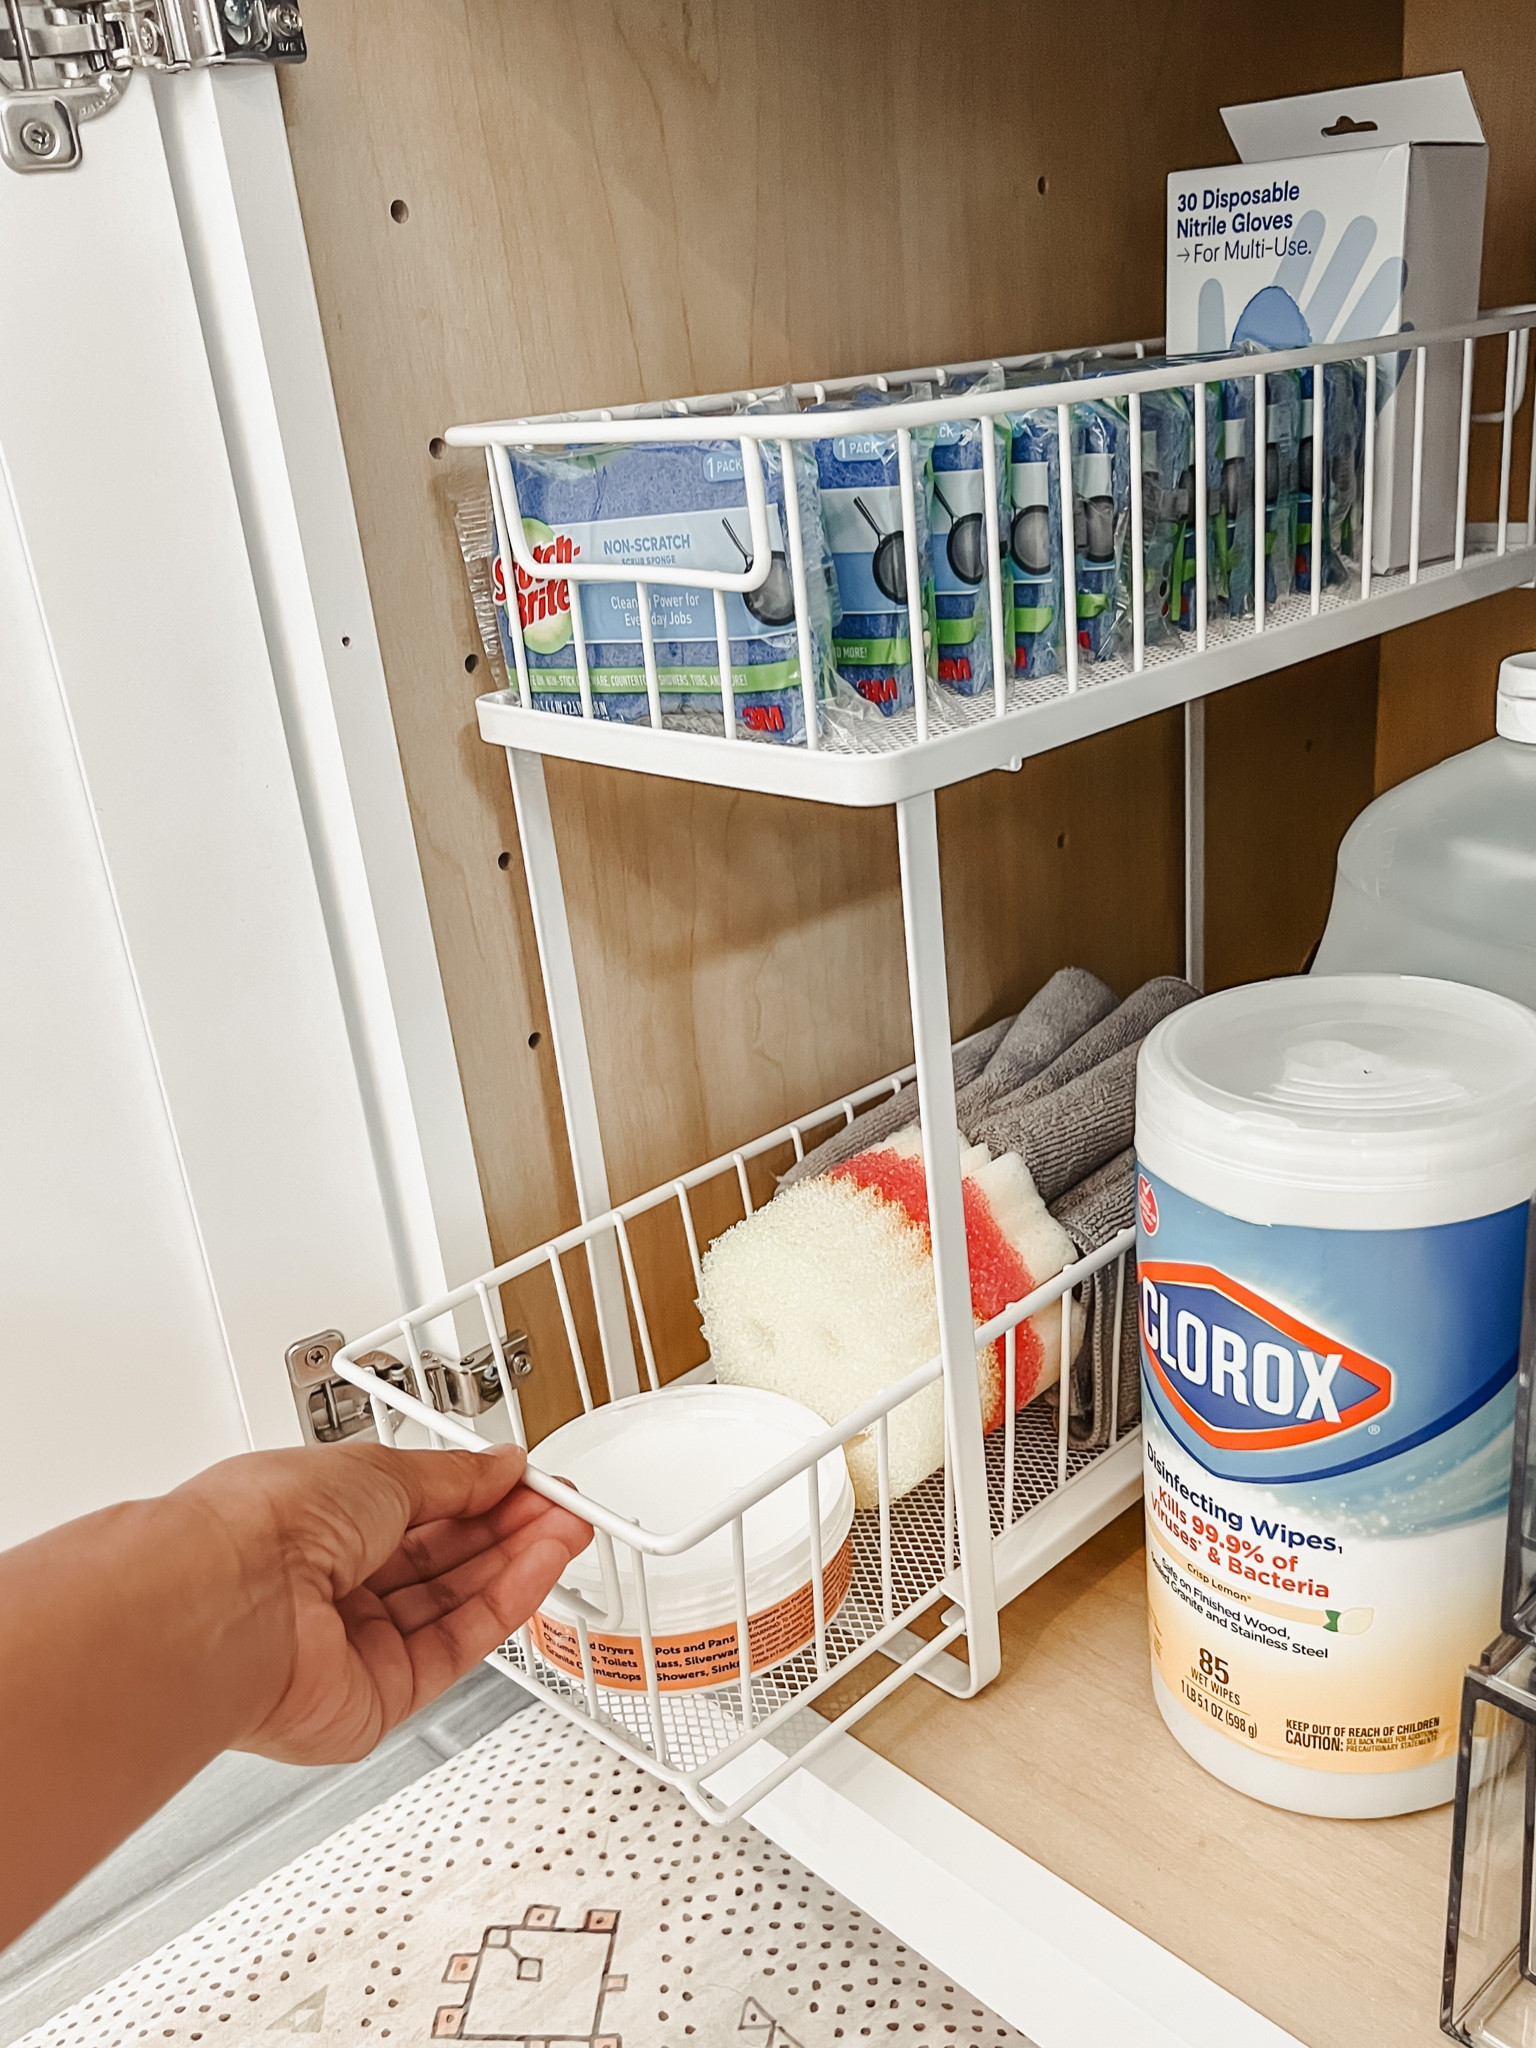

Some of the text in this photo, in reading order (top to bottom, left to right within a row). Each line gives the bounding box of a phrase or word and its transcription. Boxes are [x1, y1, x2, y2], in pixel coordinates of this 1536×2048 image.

[1177, 180, 1300, 212] 30 Disposable
[1177, 212, 1293, 239] Nitrile Gloves
[1194, 236, 1312, 263] For Multi-Use.
[838, 438, 846, 459] 1
[707, 457, 743, 478] 1 PACK
[603, 534, 690, 555] NON-SCRATCH
[653, 594, 684, 607] Power
[685, 592, 700, 606] for
[624, 611, 692, 628] Eveday Jobs
[843, 646, 868, 659] MORE!
[742, 705, 785, 732] 3M
[1142, 1276, 1343, 1424] CLOROX
[1147, 1441, 1243, 1532] Disinfecting
[1158, 1485, 1299, 1572] Kills 99.9% of
[1187, 1563, 1209, 1584] Crisp
[1207, 1546, 1221, 1566] &
[1228, 1556, 1330, 1598] Bacteria
[1161, 1558, 1291, 1640] Safe on Finished Wood,
[1171, 1582, 1204, 1614] Granite
[1206, 1610, 1228, 1628] and
[1231, 1622, 1288, 1651] Stainless
[1292, 1643, 1328, 1659] Steel
[545, 1644, 575, 1667] Granite
[598, 1643, 634, 1655] Dryers
[655, 1635, 736, 1656] Pots and Pans
[601, 1655, 638, 1668] Toilets
[654, 1648, 740, 1669] lass, Silverwar
[1199, 1647, 1230, 1685] 85
[656, 1669, 709, 1681] Showers,
[1190, 1665, 1241, 1706] WET WIPES
[1181, 1679, 1258, 1739] 1 LB 5.1 OZ (598 g)
[1286, 1716, 1440, 1738] KEEP OUT OF REACH OF CHILDREN
[1285, 1729, 1344, 1752] CAUTION:
